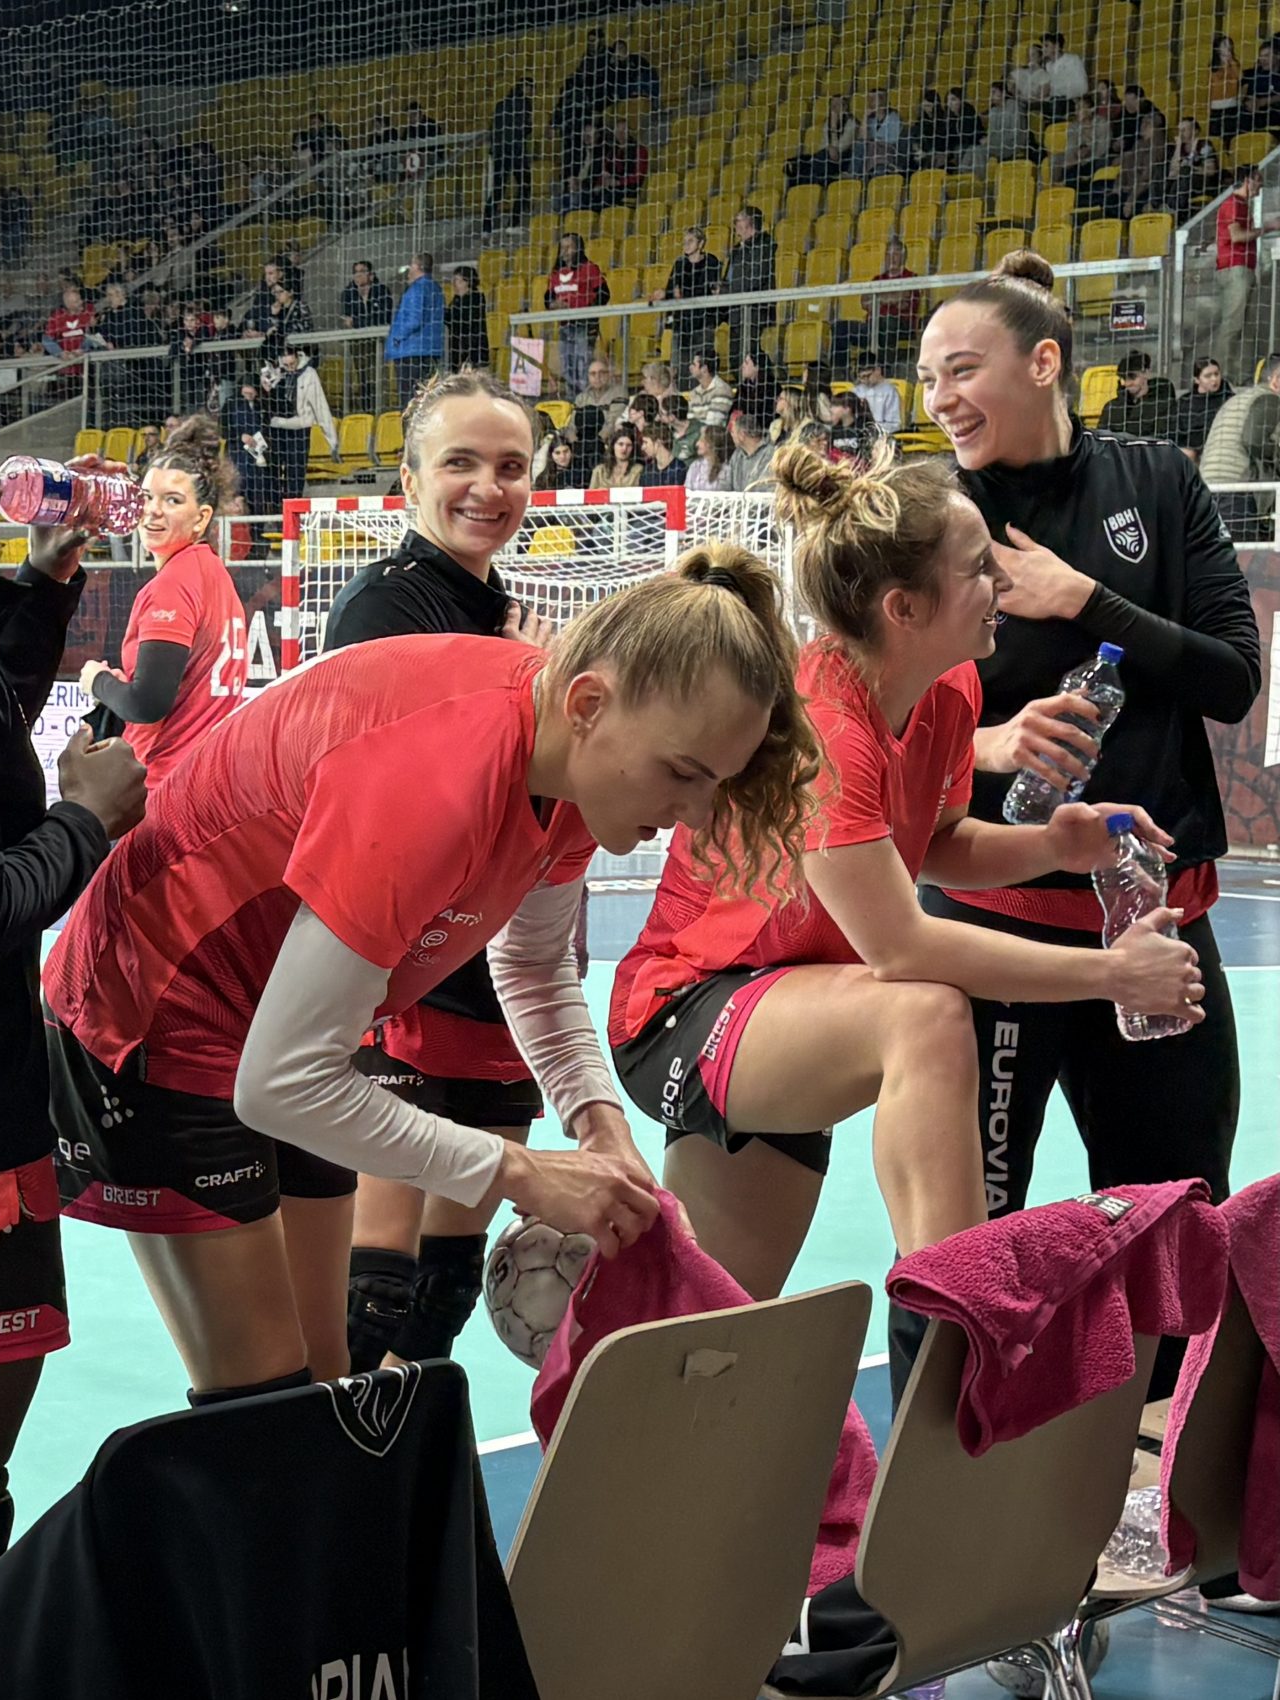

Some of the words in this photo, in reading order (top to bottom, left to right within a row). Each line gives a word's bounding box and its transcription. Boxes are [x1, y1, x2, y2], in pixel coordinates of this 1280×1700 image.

[1108, 508, 1136, 531] BBH
[701, 997, 737, 1062] BREST
[985, 1021, 1020, 1212] EUROVIA
[195, 1165, 254, 1188] CRAFT
[103, 1185, 161, 1207] BREST
